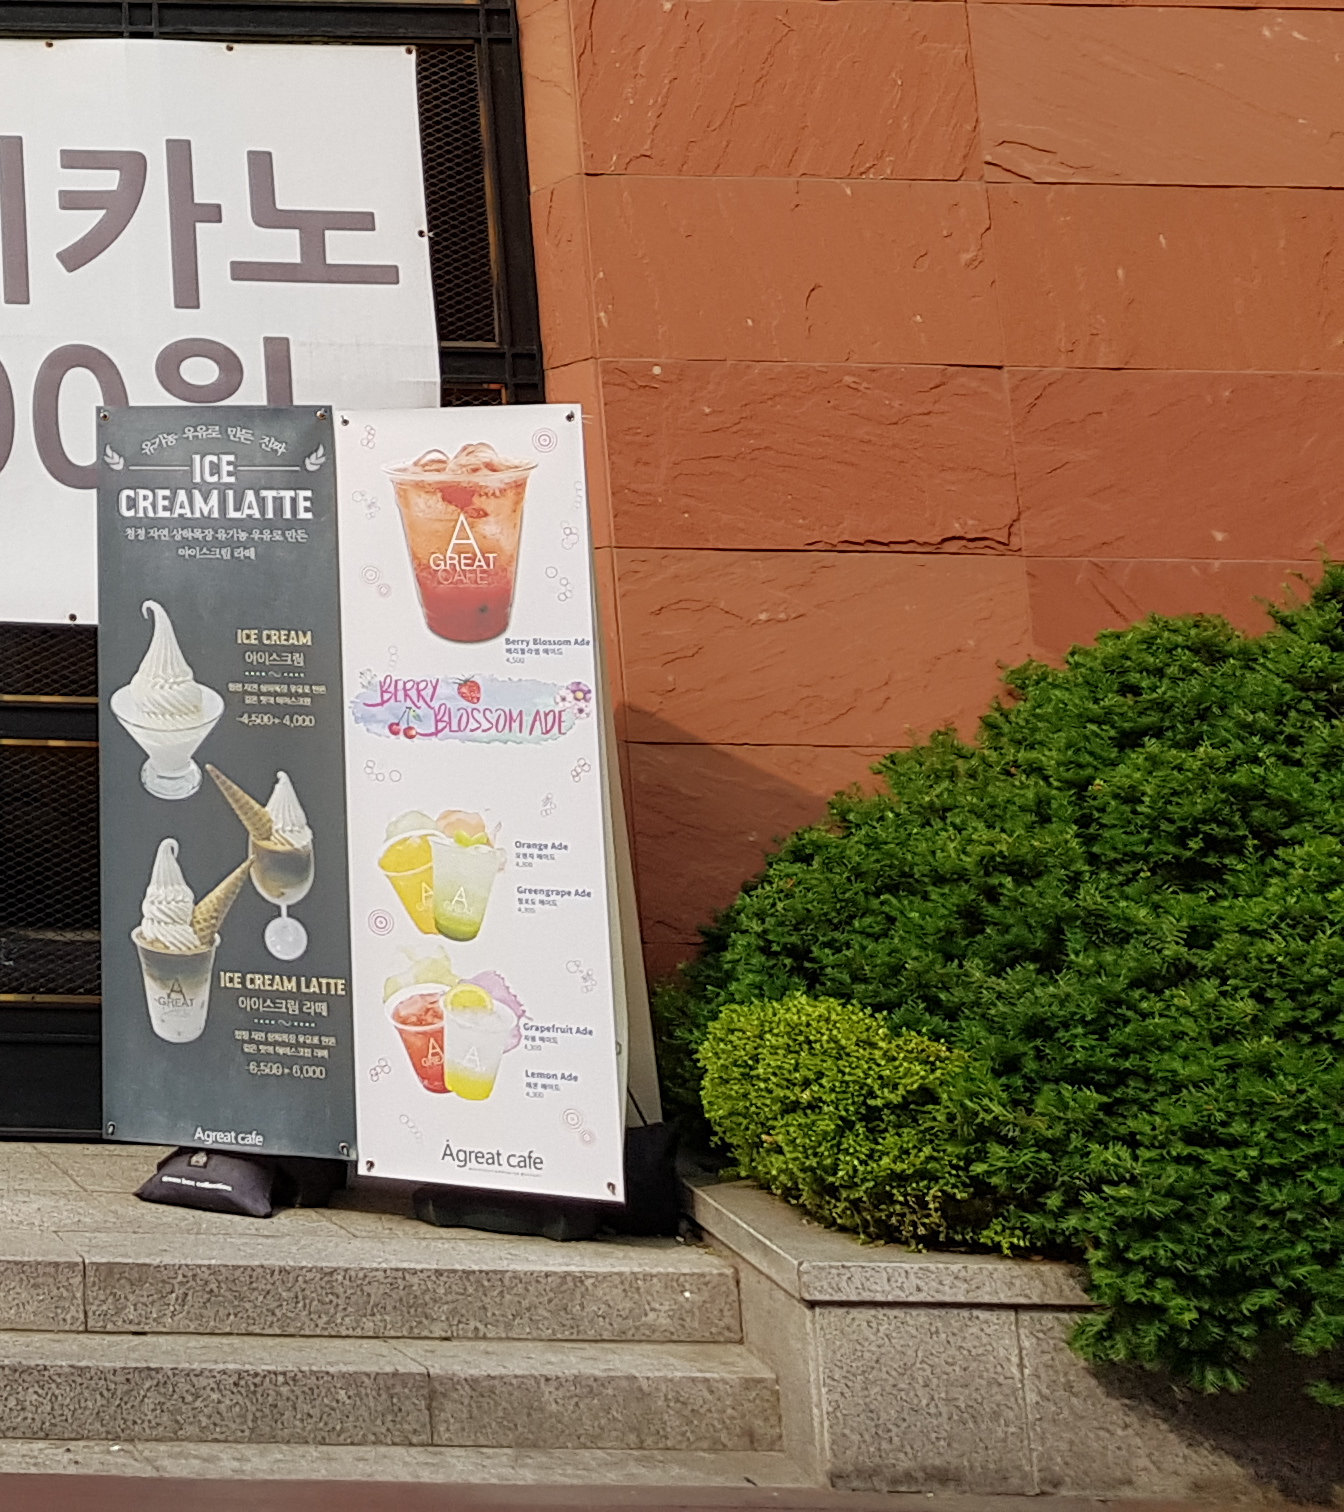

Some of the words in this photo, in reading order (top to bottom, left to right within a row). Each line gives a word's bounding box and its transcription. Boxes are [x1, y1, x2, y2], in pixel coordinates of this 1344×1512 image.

[141, 432, 179, 456] 유기농
[182, 425, 222, 439] 우유로
[227, 426, 255, 444] 만든
[191, 454, 236, 483] ICE
[118, 489, 219, 519] CREAM
[225, 489, 314, 520] LATTE
[429, 553, 498, 570] GREAT
[236, 629, 259, 644] ICE
[262, 630, 312, 645] CREAM
[505, 638, 530, 647] Berry
[532, 638, 571, 646] Blossom
[573, 638, 590, 646] Ade
[365, 675, 440, 710] BERRY
[282, 714, 316, 728] 4,000
[418, 703, 524, 737] BLOSSOM
[529, 709, 567, 736] ADE
[517, 886, 572, 898] Greengrape
[574, 889, 592, 898] Ade
[219, 971, 242, 988] ICE
[246, 973, 297, 992] CREAM
[300, 977, 346, 995] LATTE
[525, 1069, 558, 1080] Lemon
[560, 1072, 579, 1082] Ade
[194, 1127, 236, 1145] Agreat
[238, 1131, 264, 1145] cafe
[441, 1139, 503, 1168] Agreat
[506, 1149, 544, 1170] cafe
